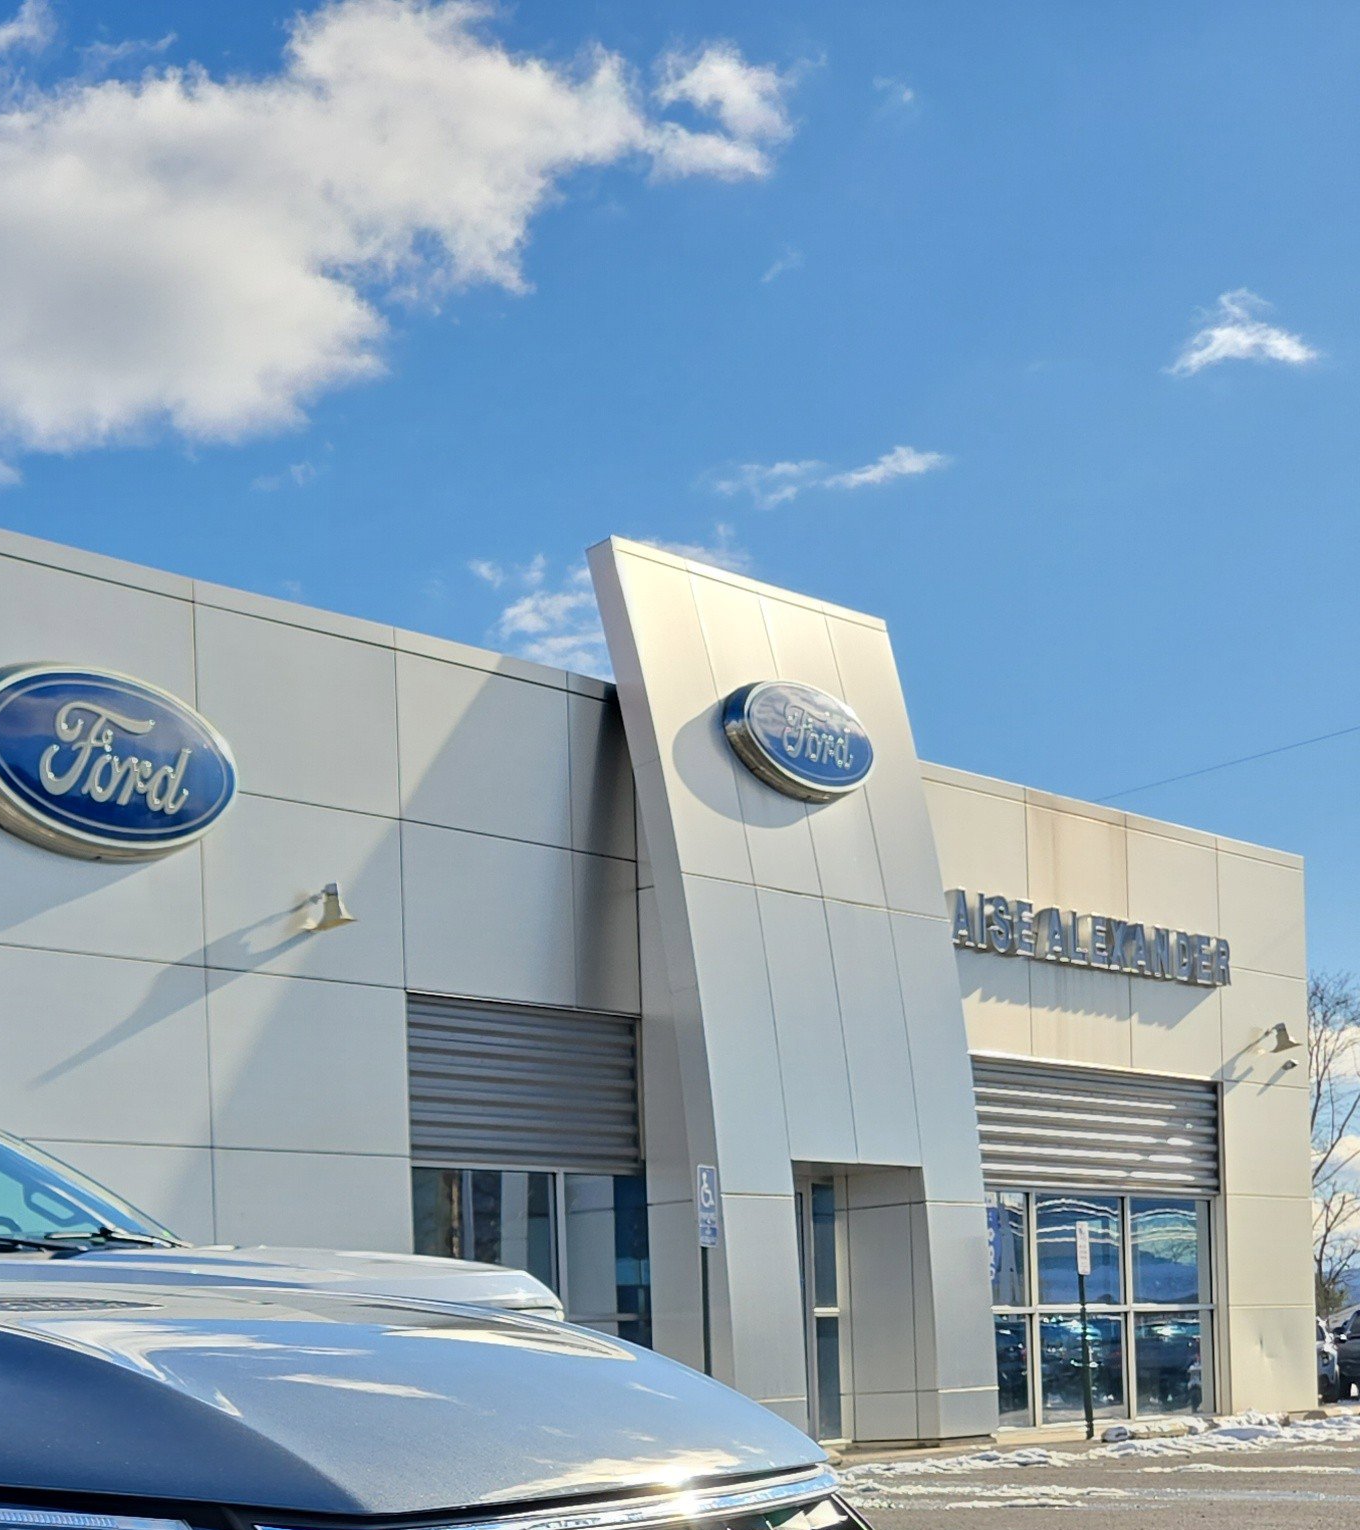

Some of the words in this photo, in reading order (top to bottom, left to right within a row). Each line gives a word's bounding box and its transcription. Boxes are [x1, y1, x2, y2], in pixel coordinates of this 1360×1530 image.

[39, 701, 192, 815] Ford
[782, 703, 854, 770] Ford
[1036, 905, 1231, 985] ALEXANDER
